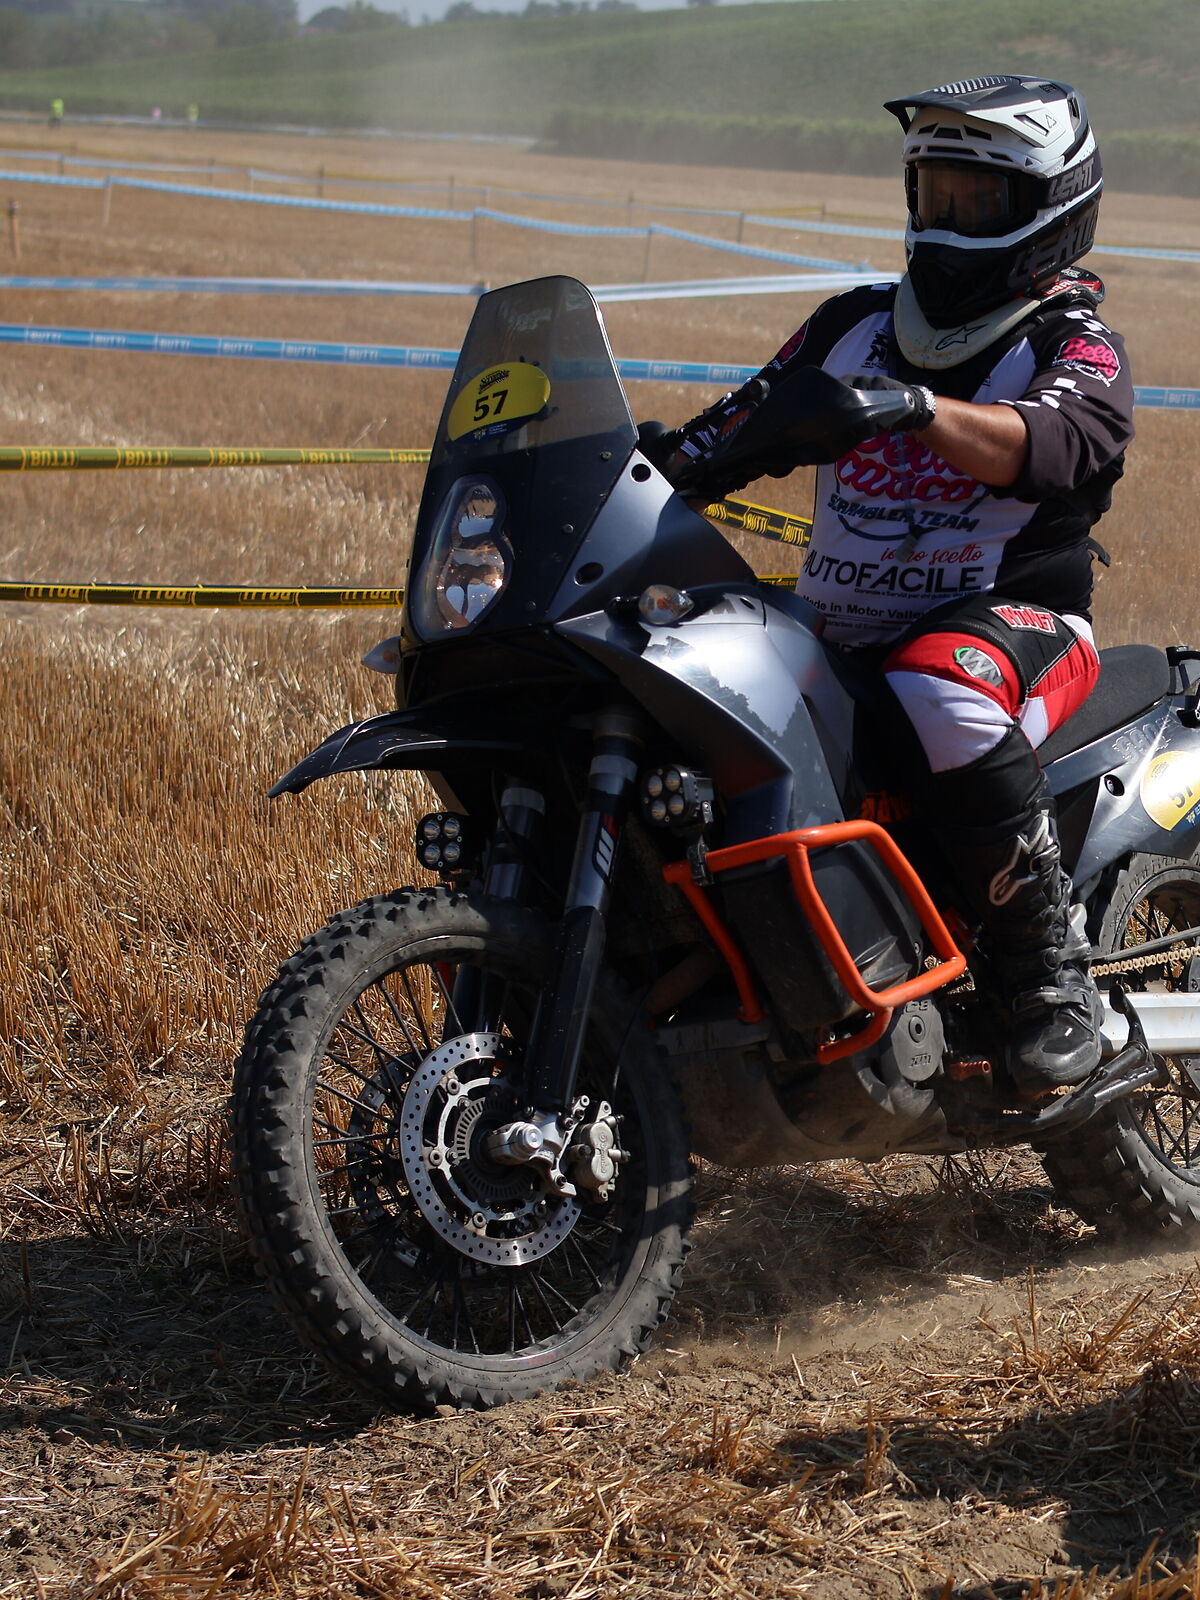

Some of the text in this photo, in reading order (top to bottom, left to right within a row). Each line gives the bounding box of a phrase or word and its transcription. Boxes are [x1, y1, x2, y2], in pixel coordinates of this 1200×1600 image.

[653, 365, 682, 376] BUTTI
[712, 368, 741, 379] BUTTI
[473, 389, 509, 422] 57
[1168, 393, 1195, 403] BUTTI
[747, 513, 769, 534] BUTTI
[919, 510, 980, 533] TEAM
[784, 524, 804, 545] BUTTI
[929, 544, 984, 566] scelto
[803, 549, 984, 593] AUTOFACILE
[830, 602, 841, 612] in
[847, 604, 884, 617] Motor
